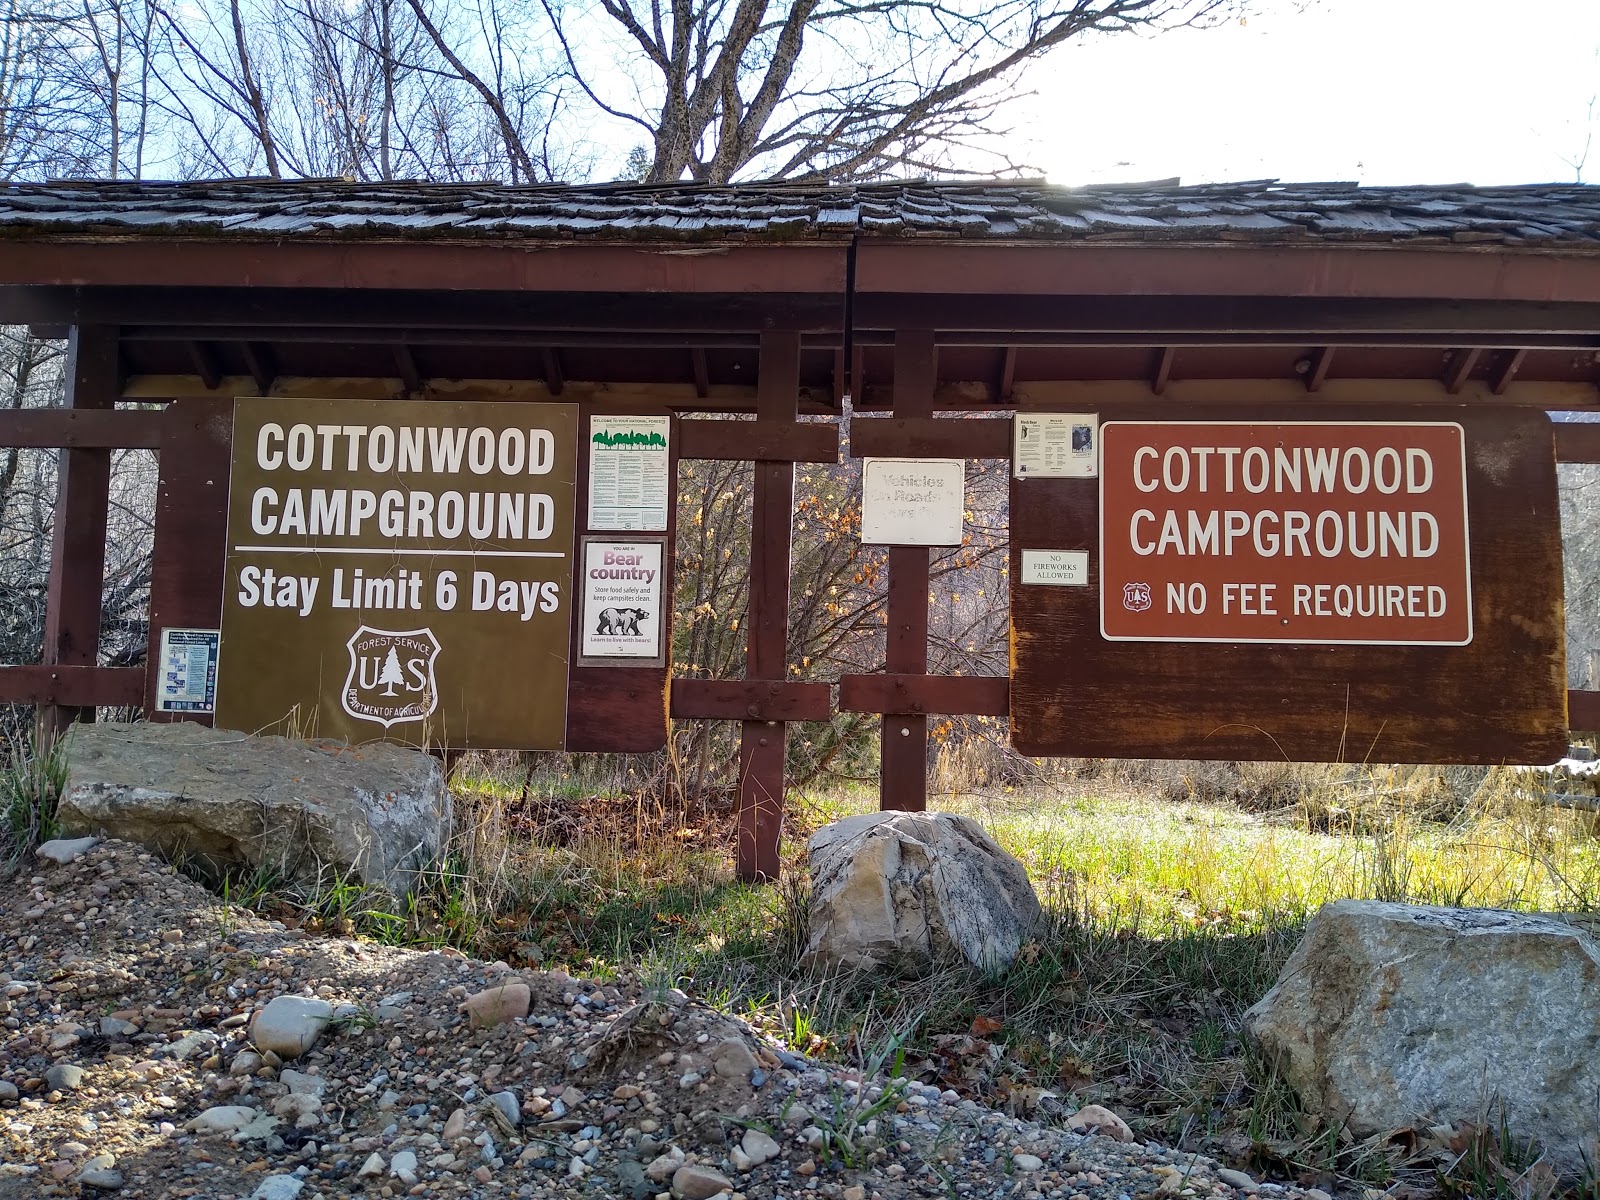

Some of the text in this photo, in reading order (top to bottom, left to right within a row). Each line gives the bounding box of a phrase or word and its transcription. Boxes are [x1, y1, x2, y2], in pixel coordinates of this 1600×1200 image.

[256, 422, 555, 475] COTTONWOOD
[882, 474, 945, 488] Vehicles
[1133, 446, 1434, 495] COTTONWOOD
[251, 486, 555, 540] CAMPGROUND
[1130, 508, 1440, 558] CAMPGROUND
[603, 551, 643, 566] Bear
[589, 567, 656, 585] country
[623, 586, 640, 595] safely
[238, 565, 559, 621] Stay Limit 6 Days
[1166, 582, 1447, 618] NO FEE REQUIRED
[357, 637, 430, 656] FOREST SERVICE
[348, 688, 384, 716] DEPARTMENT
[384, 707, 393, 716] OF
